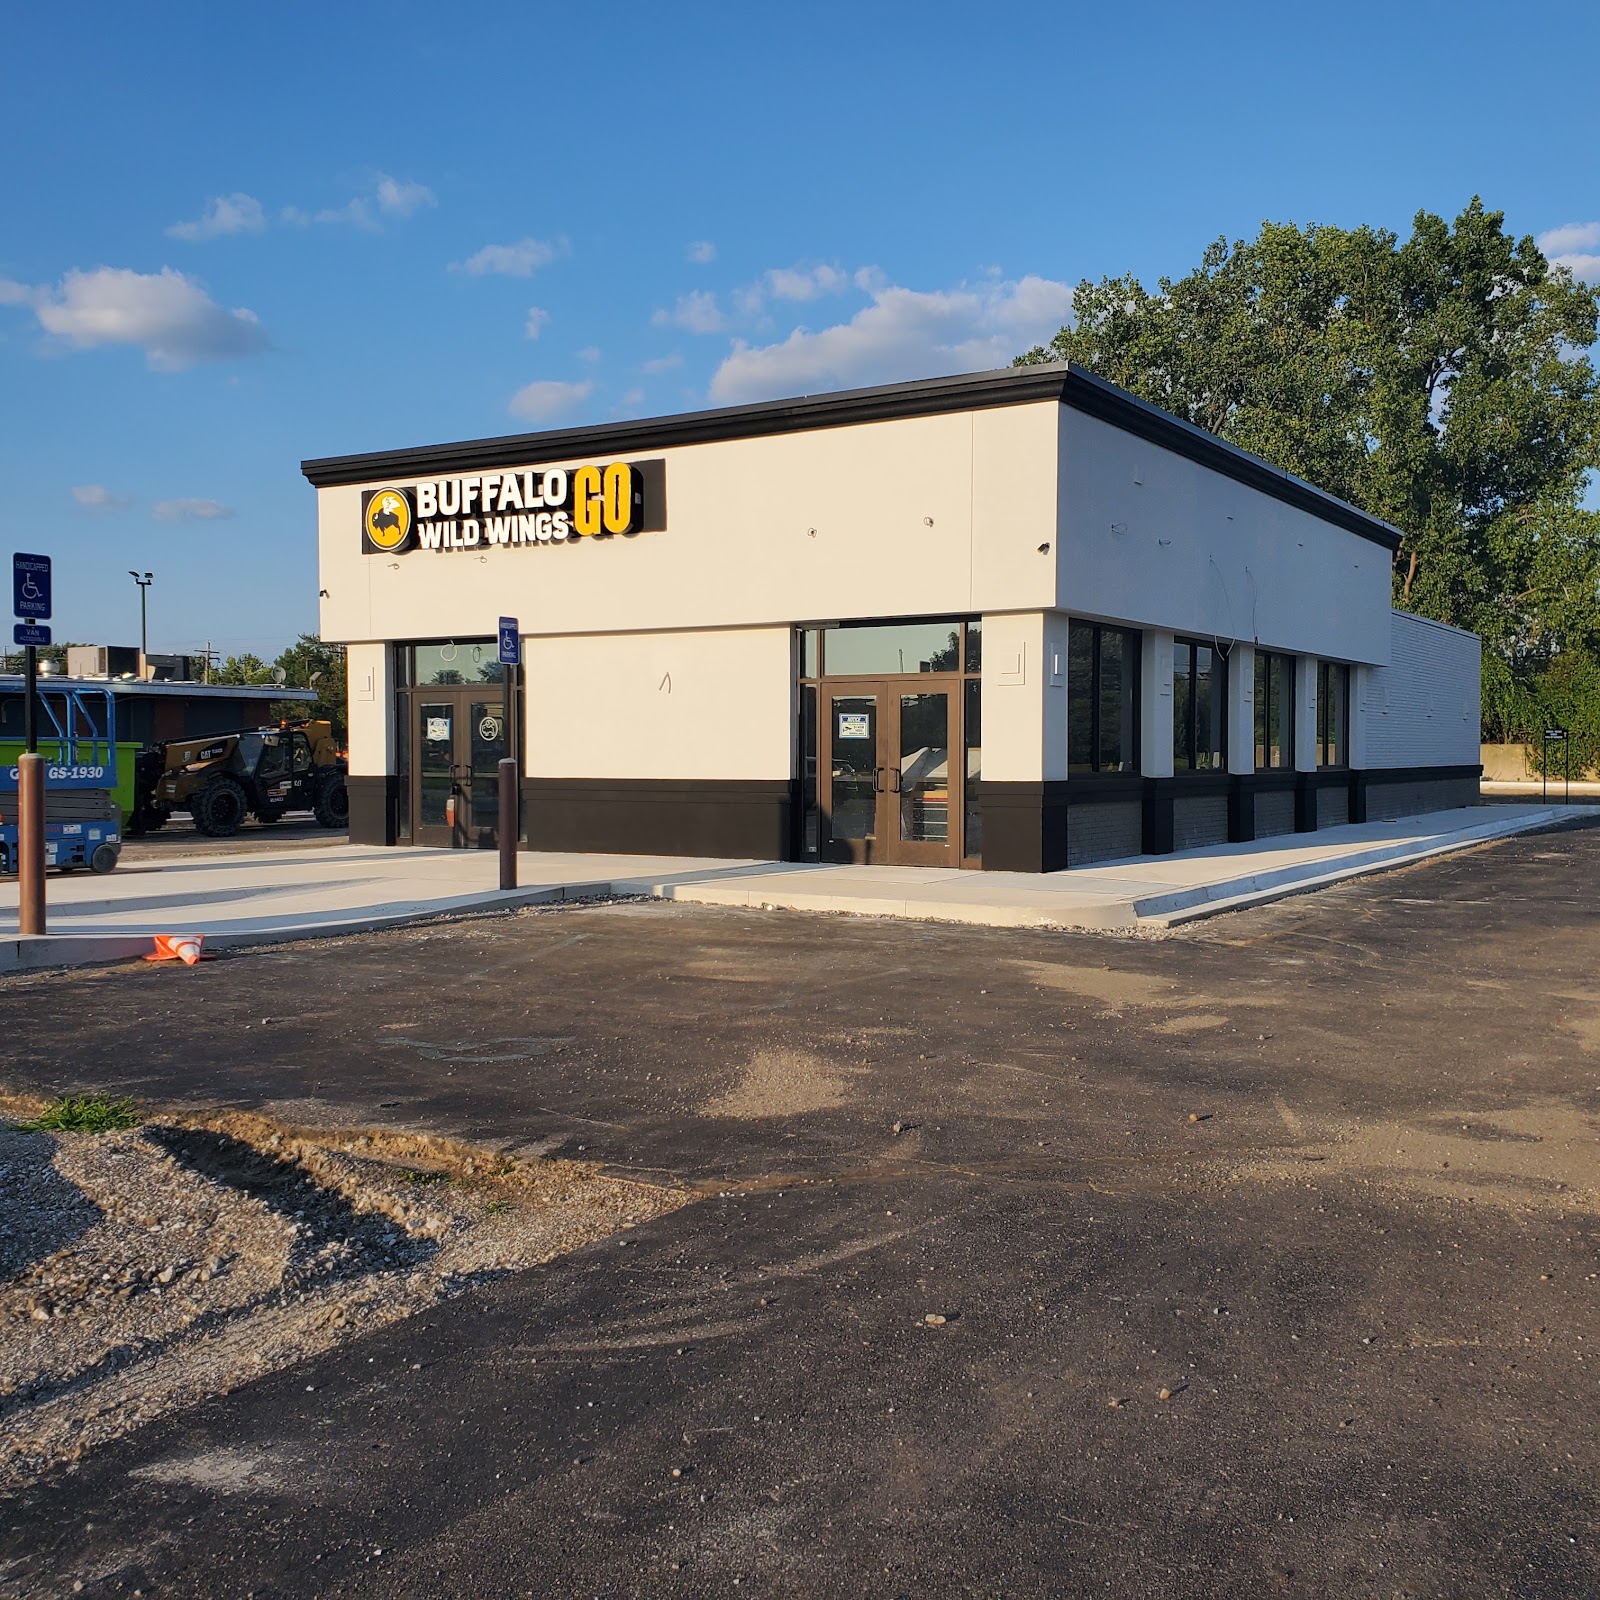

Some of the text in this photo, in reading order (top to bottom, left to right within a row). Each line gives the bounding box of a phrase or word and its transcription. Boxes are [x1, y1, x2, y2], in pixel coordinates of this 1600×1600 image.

[416, 462, 631, 536] BUFFALO GO
[417, 511, 569, 549] WILD WINGS
[20, 601, 46, 611] PARKING
[201, 750, 211, 759] CAT
[48, 766, 104, 779] GS-1930
